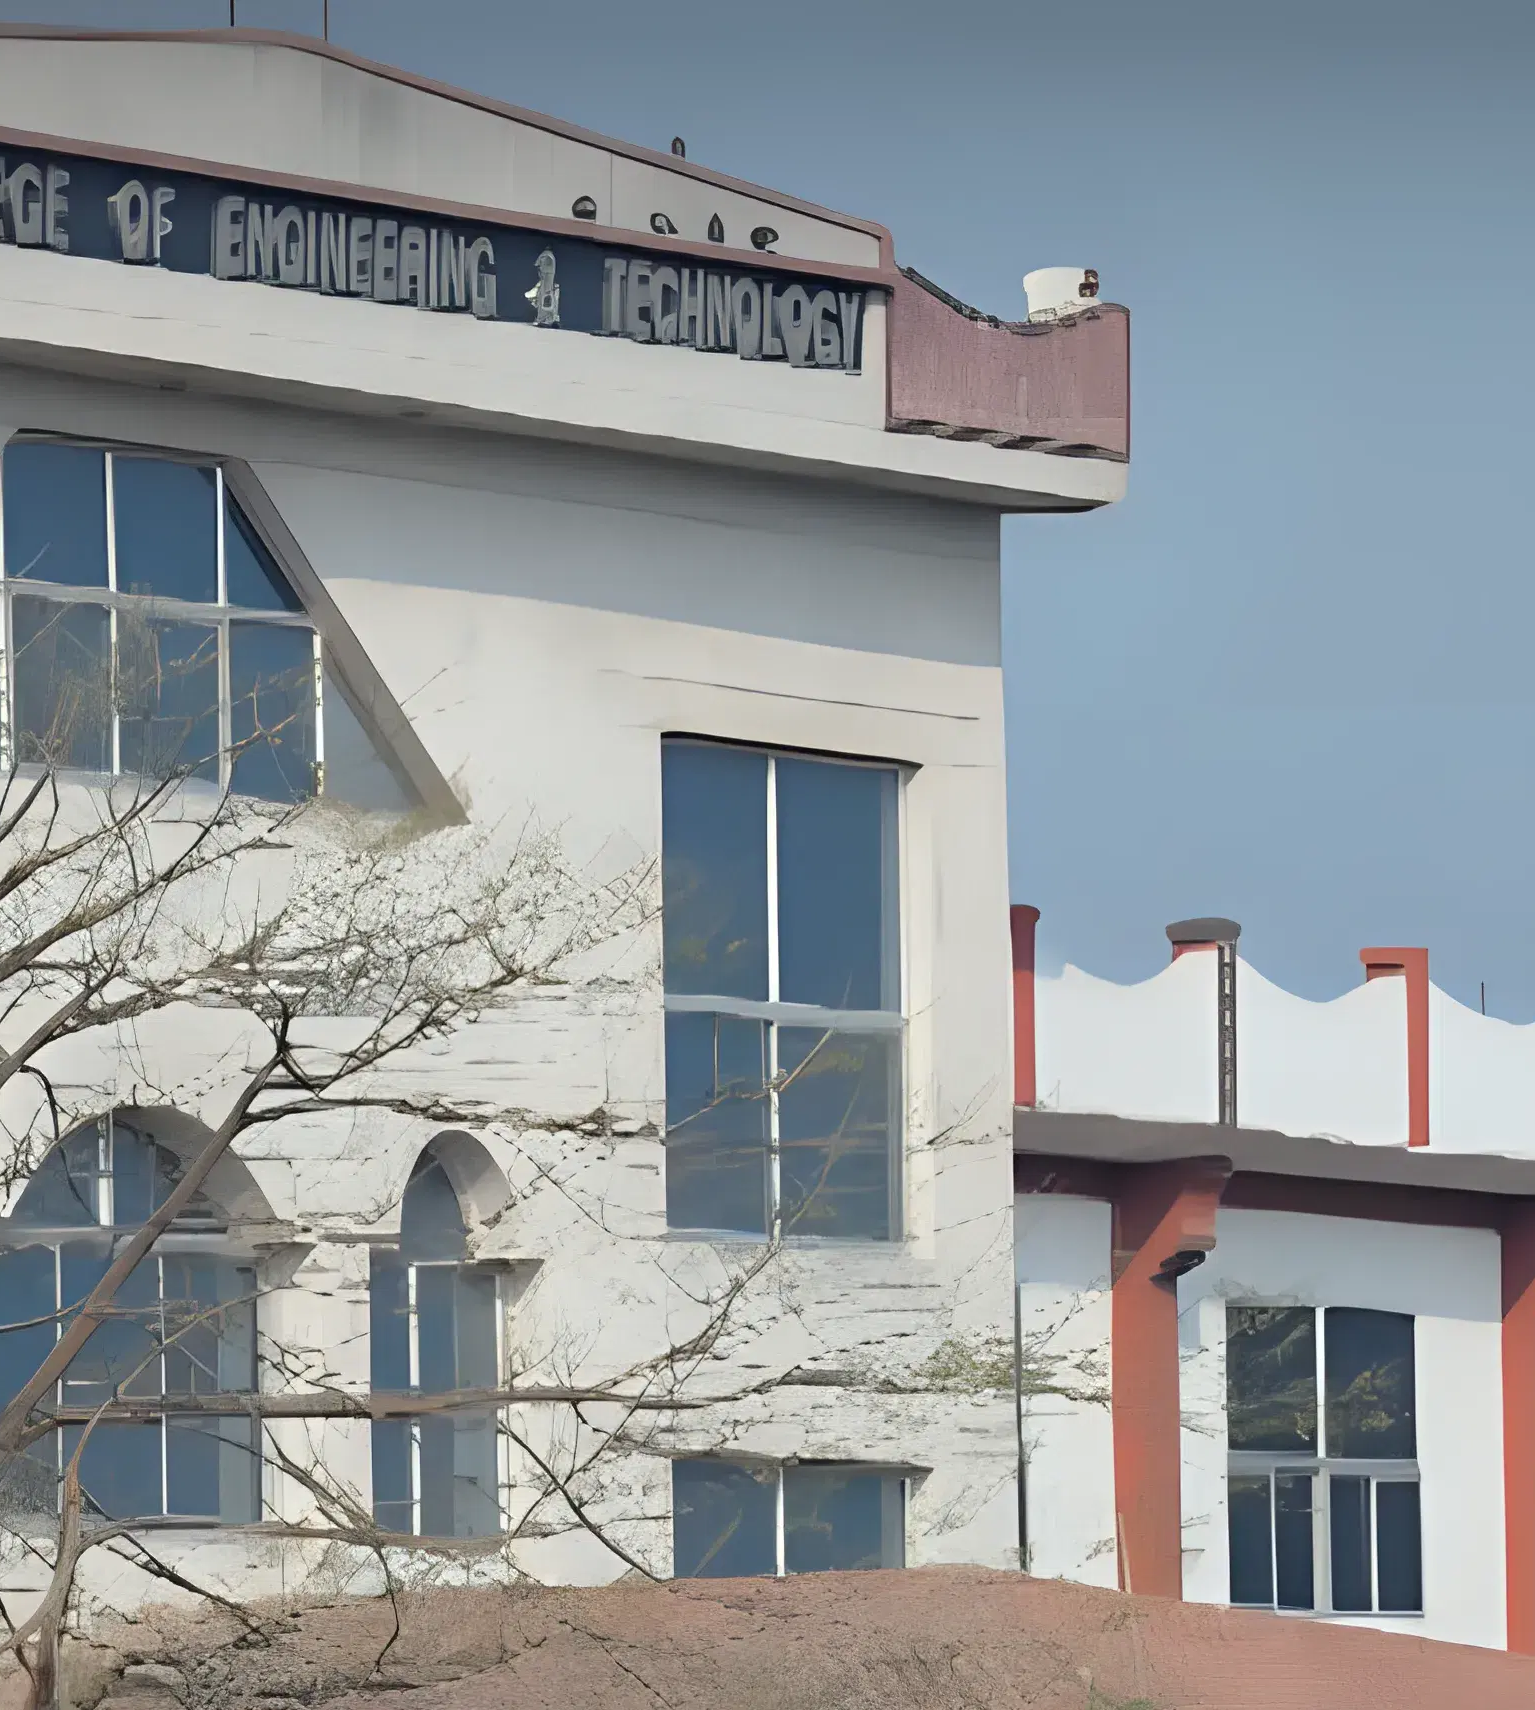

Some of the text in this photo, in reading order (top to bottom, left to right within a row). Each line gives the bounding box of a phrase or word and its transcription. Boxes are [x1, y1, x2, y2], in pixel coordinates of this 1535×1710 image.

[107, 179, 176, 264] OF
[210, 195, 498, 319] ENGINEERING
[603, 258, 862, 374] TECHNOLOGY
